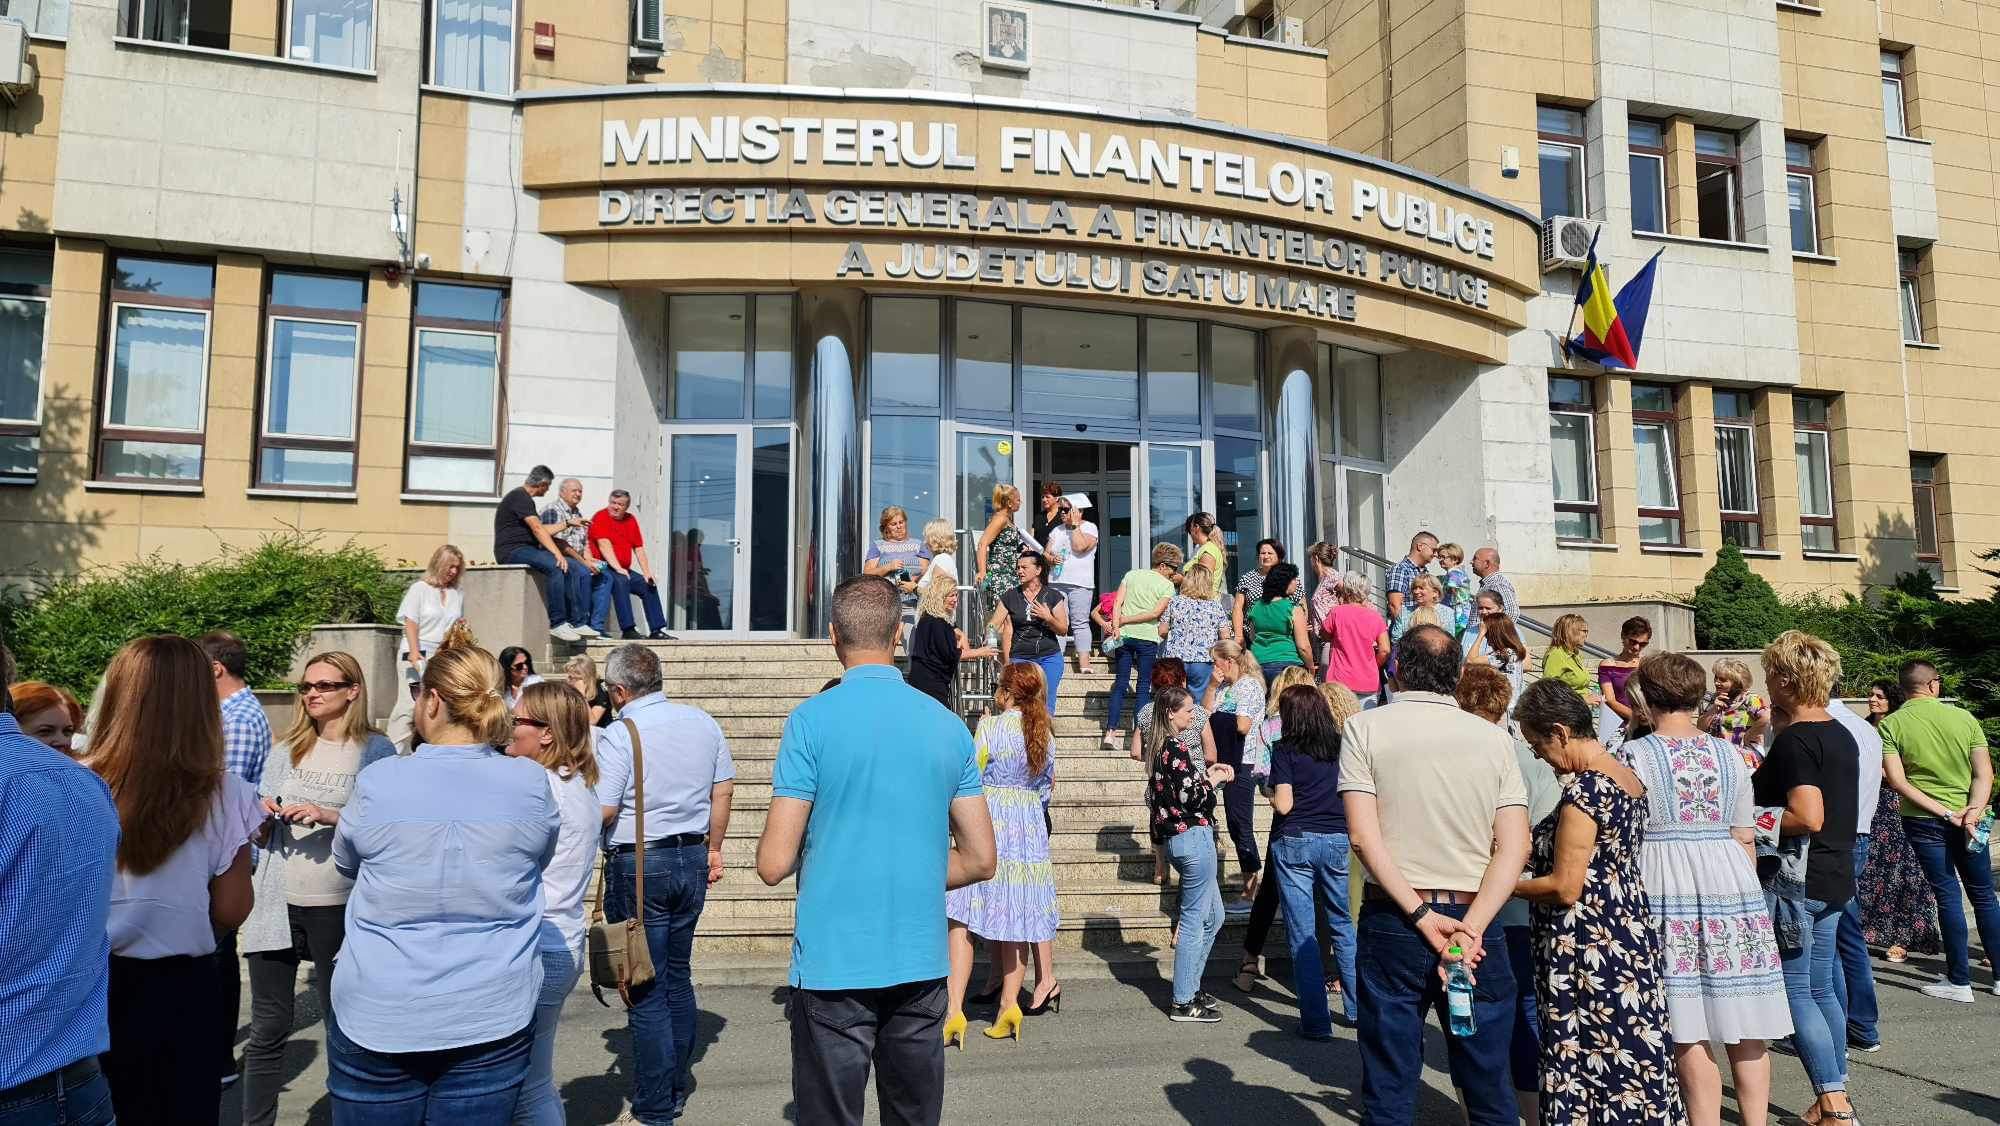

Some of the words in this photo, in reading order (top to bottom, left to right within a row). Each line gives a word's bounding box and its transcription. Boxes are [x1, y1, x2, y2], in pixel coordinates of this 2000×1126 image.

[599, 187, 816, 225] DIRECTIA
[823, 190, 1078, 233] GENERALA
[1087, 204, 1122, 238] A
[1134, 207, 1368, 276] FINANTELOR
[1380, 251, 1490, 309] PUBLICE
[603, 116, 976, 168] MINISTERUL
[1000, 127, 1335, 212] FINANTELOR
[1352, 179, 1496, 259] PUBLICE
[836, 241, 874, 279] A
[885, 242, 1130, 291] JUDETULUI
[1142, 260, 1249, 303] SATU
[1255, 275, 1357, 321] MARE
